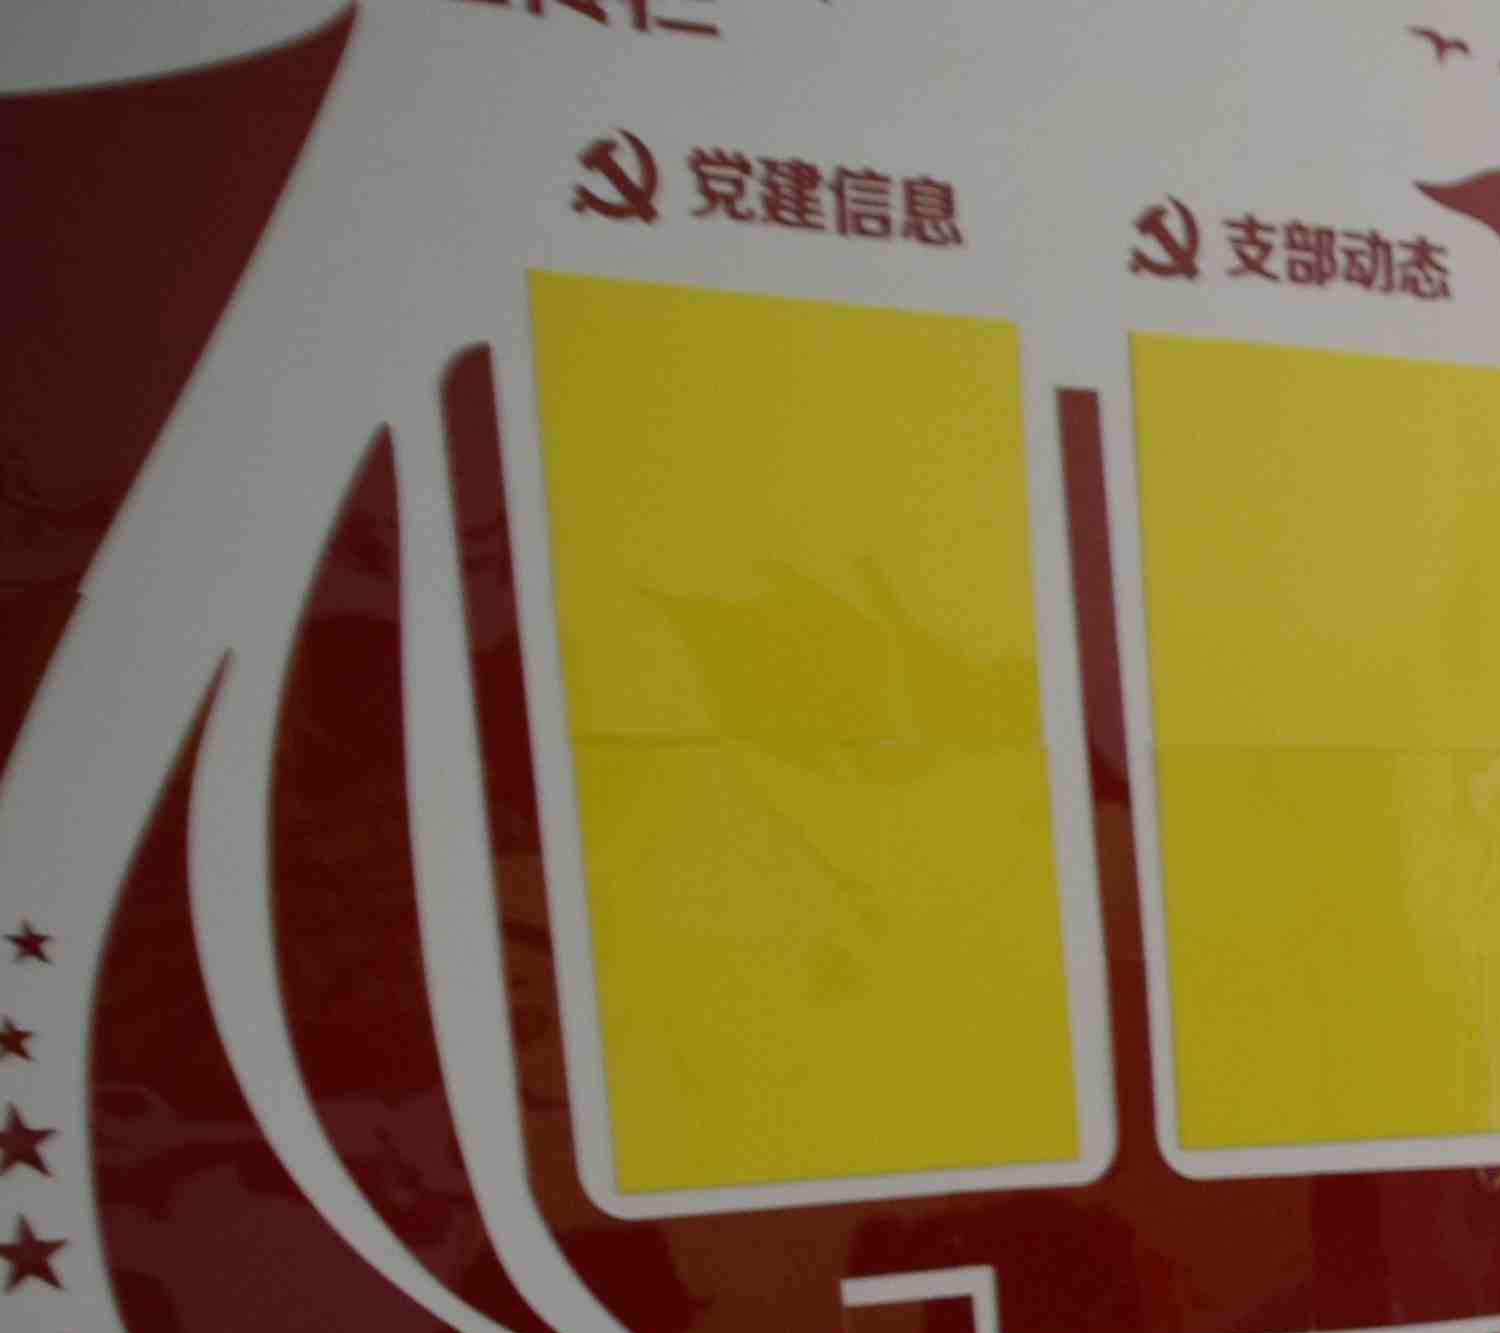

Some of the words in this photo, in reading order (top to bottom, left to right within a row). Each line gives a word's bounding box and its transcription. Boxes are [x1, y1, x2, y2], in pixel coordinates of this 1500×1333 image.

[687, 147, 964, 247] 党建信息
[1222, 212, 1451, 301] 支部动态
